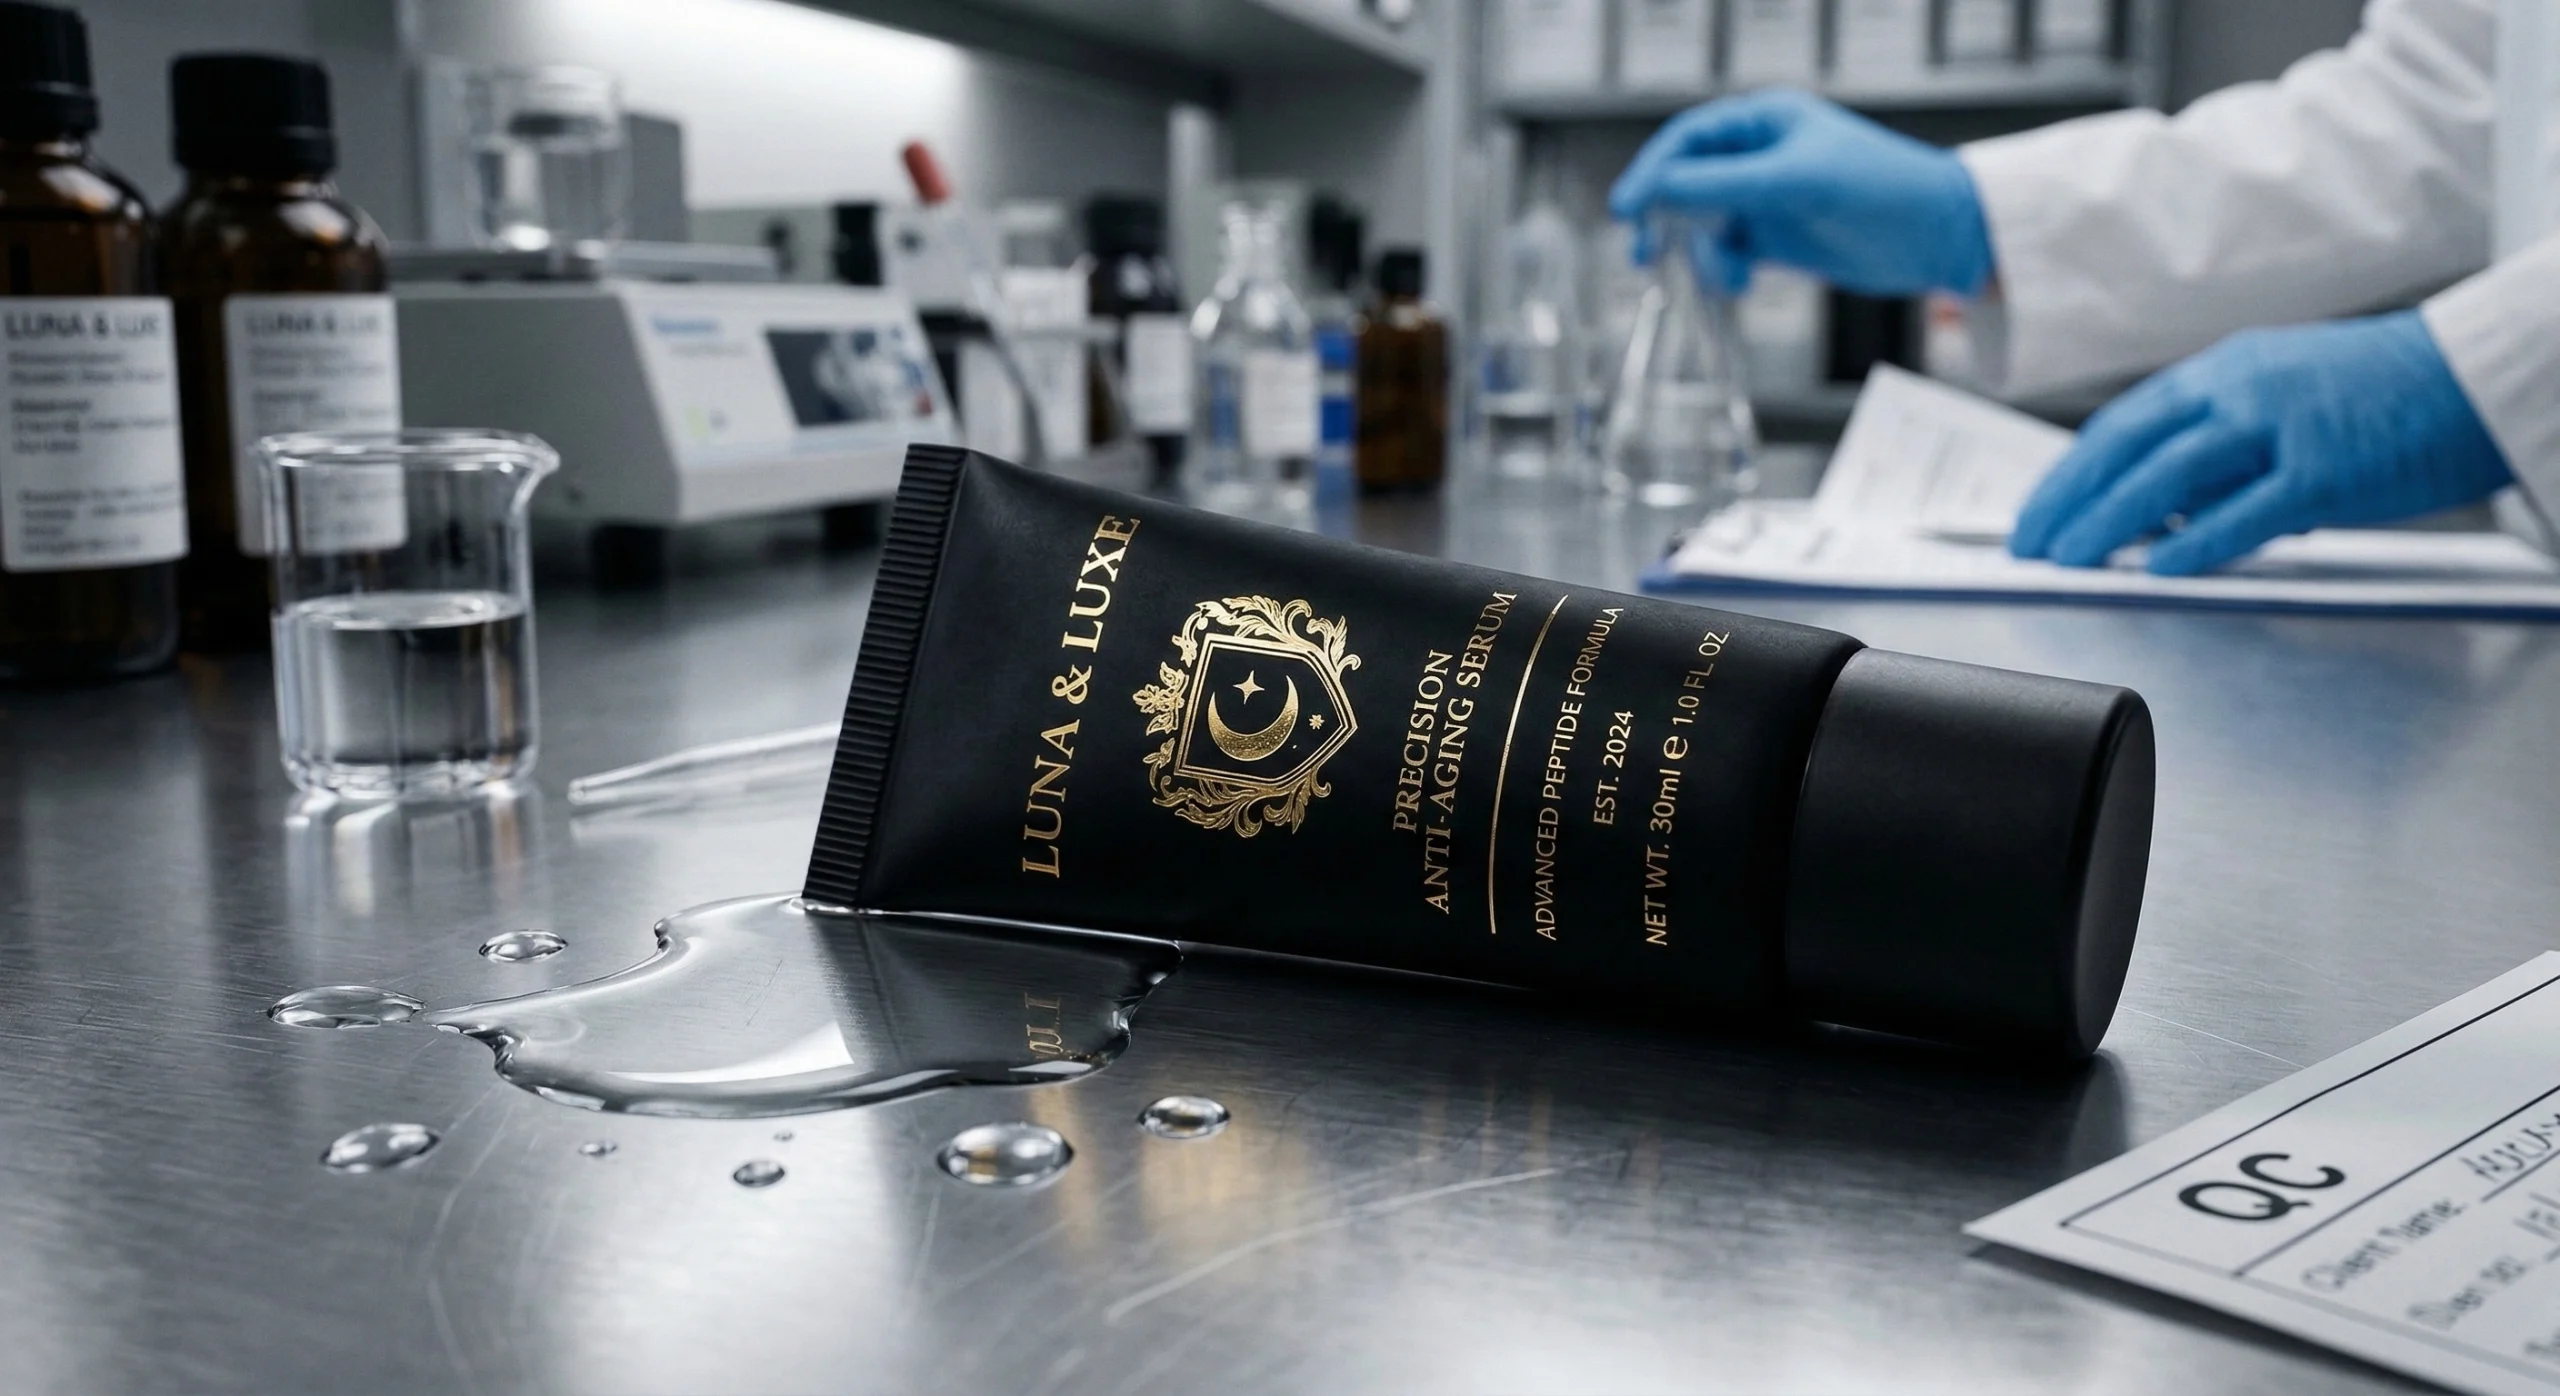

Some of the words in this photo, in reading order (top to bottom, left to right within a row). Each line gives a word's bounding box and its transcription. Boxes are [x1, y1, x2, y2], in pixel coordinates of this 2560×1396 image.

[5, 312, 86, 340] LUNA
[1062, 514, 1141, 653] LUXE
[1052, 664, 1092, 705] &
[1566, 606, 1624, 697] FORMULA
[1682, 663, 1714, 689] FL
[1393, 649, 1454, 833] PRECISION
[1603, 710, 1634, 769] 2024
[1672, 694, 1700, 727] 1.0
[1424, 697, 1475, 914] ANTI-AGING
[1456, 590, 1518, 688] SERUM
[1543, 702, 1583, 800] PEPTIDE
[1022, 719, 1080, 878] LUNA
[1593, 776, 1620, 825] EST.
[1650, 768, 1681, 835] 30ml
[1535, 806, 1559, 941] ADVANCED
[1645, 844, 1671, 890] WT.
[1644, 895, 1668, 946] NET
[2178, 1153, 2346, 1222] QC
